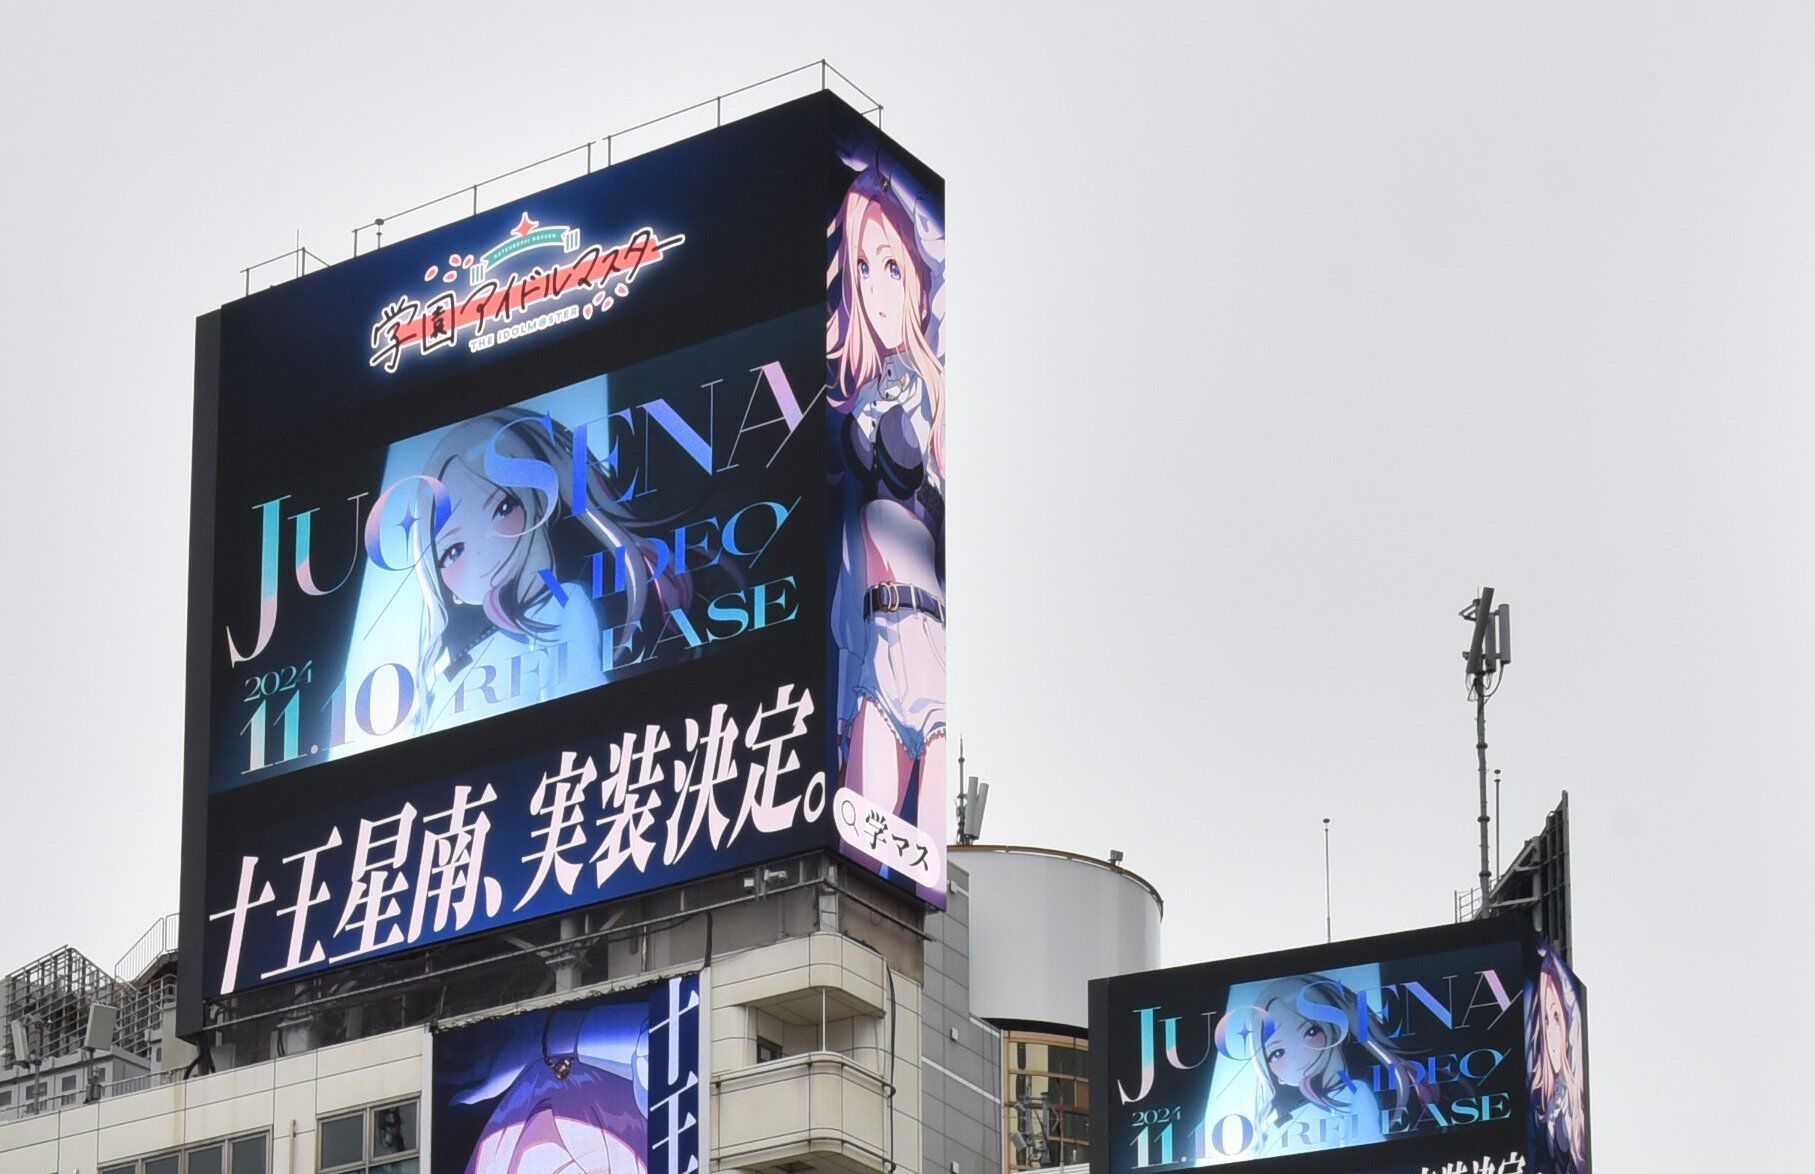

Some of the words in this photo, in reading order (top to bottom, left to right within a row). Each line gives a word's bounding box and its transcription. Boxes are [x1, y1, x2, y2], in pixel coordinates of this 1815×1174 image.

[370, 228, 684, 370] 学園アイドルマスター
[470, 334, 494, 352] THE
[483, 361, 826, 537] SENA
[537, 497, 801, 609] VIDEO
[240, 662, 415, 774] 11.10
[446, 576, 800, 720] RELEASE
[243, 659, 313, 702] 2024
[863, 809, 928, 871] 学マス
[1297, 969, 1523, 1051] SENA
[1337, 1048, 1511, 1095] VIDEO
[1130, 1113, 1254, 1169] 11.10
[1276, 1093, 1512, 1148] RELEASE
[1132, 1106, 1181, 1127] 2024
